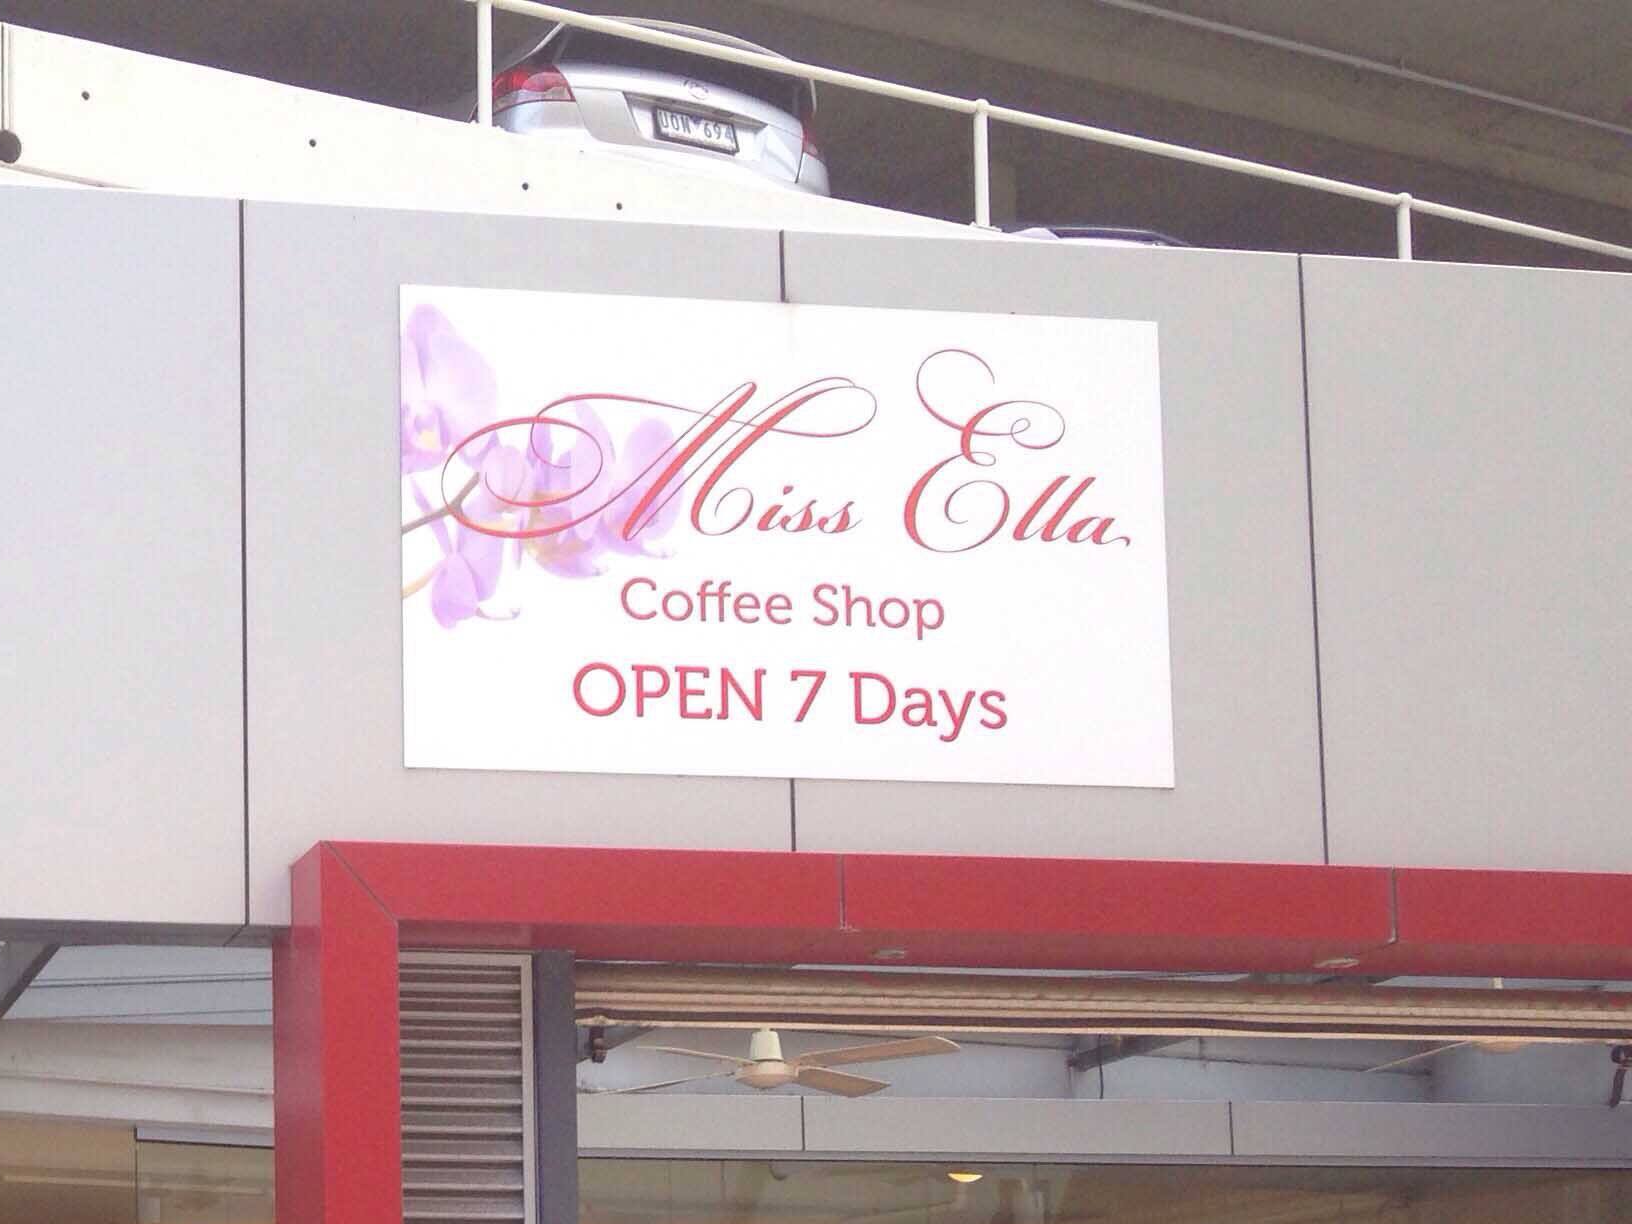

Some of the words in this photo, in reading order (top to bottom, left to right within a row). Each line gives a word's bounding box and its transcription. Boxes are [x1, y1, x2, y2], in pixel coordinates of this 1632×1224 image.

[441, 376, 878, 541] Miss
[903, 348, 1131, 552] Ella
[620, 576, 793, 626] Coffee
[812, 583, 945, 641] Shop
[571, 660, 767, 722] OPEN
[789, 668, 827, 723] 7
[850, 671, 1008, 742] Days
